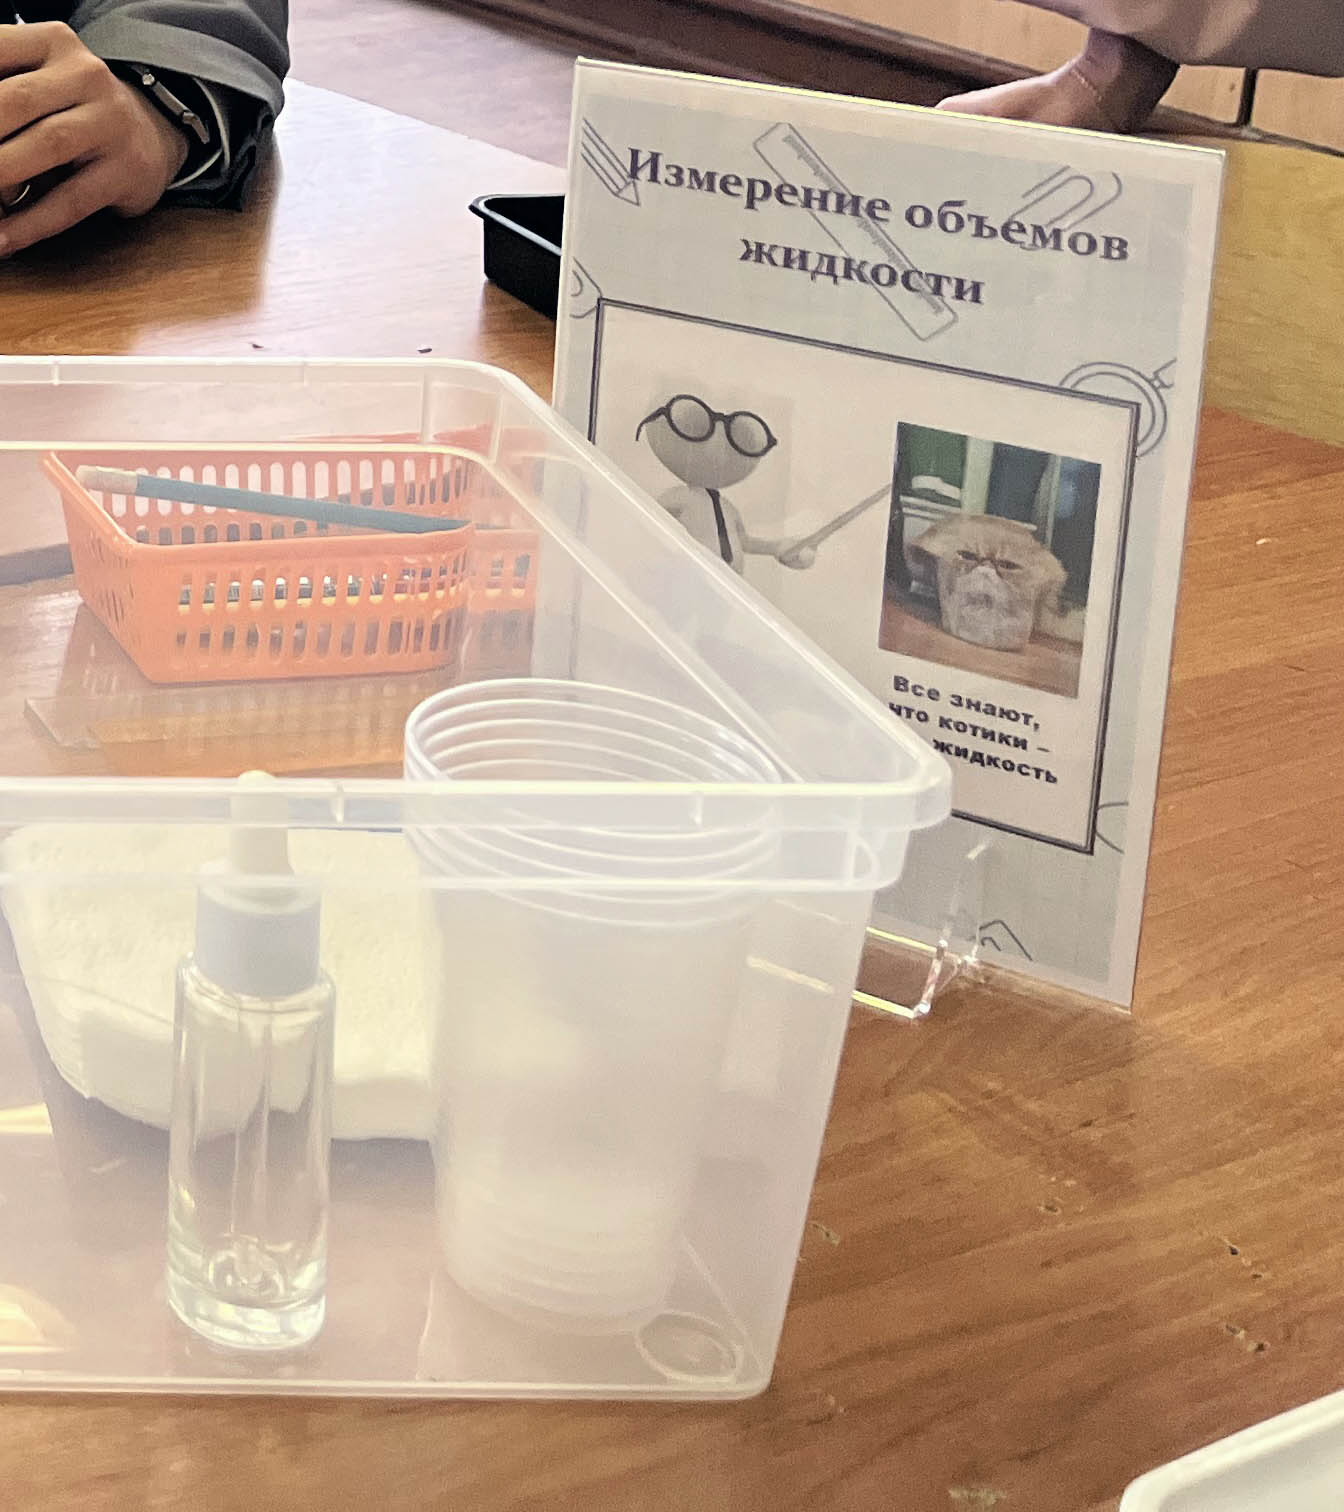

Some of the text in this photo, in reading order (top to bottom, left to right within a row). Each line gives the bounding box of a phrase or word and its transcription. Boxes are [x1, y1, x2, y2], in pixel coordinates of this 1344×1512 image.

[627, 146, 1131, 262] Измерение объемов
[739, 237, 987, 305] жидкости
[888, 701, 929, 724] что
[938, 715, 1029, 751] котики
[893, 674, 1041, 732] Все знают,
[932, 738, 1058, 785] жидкость
